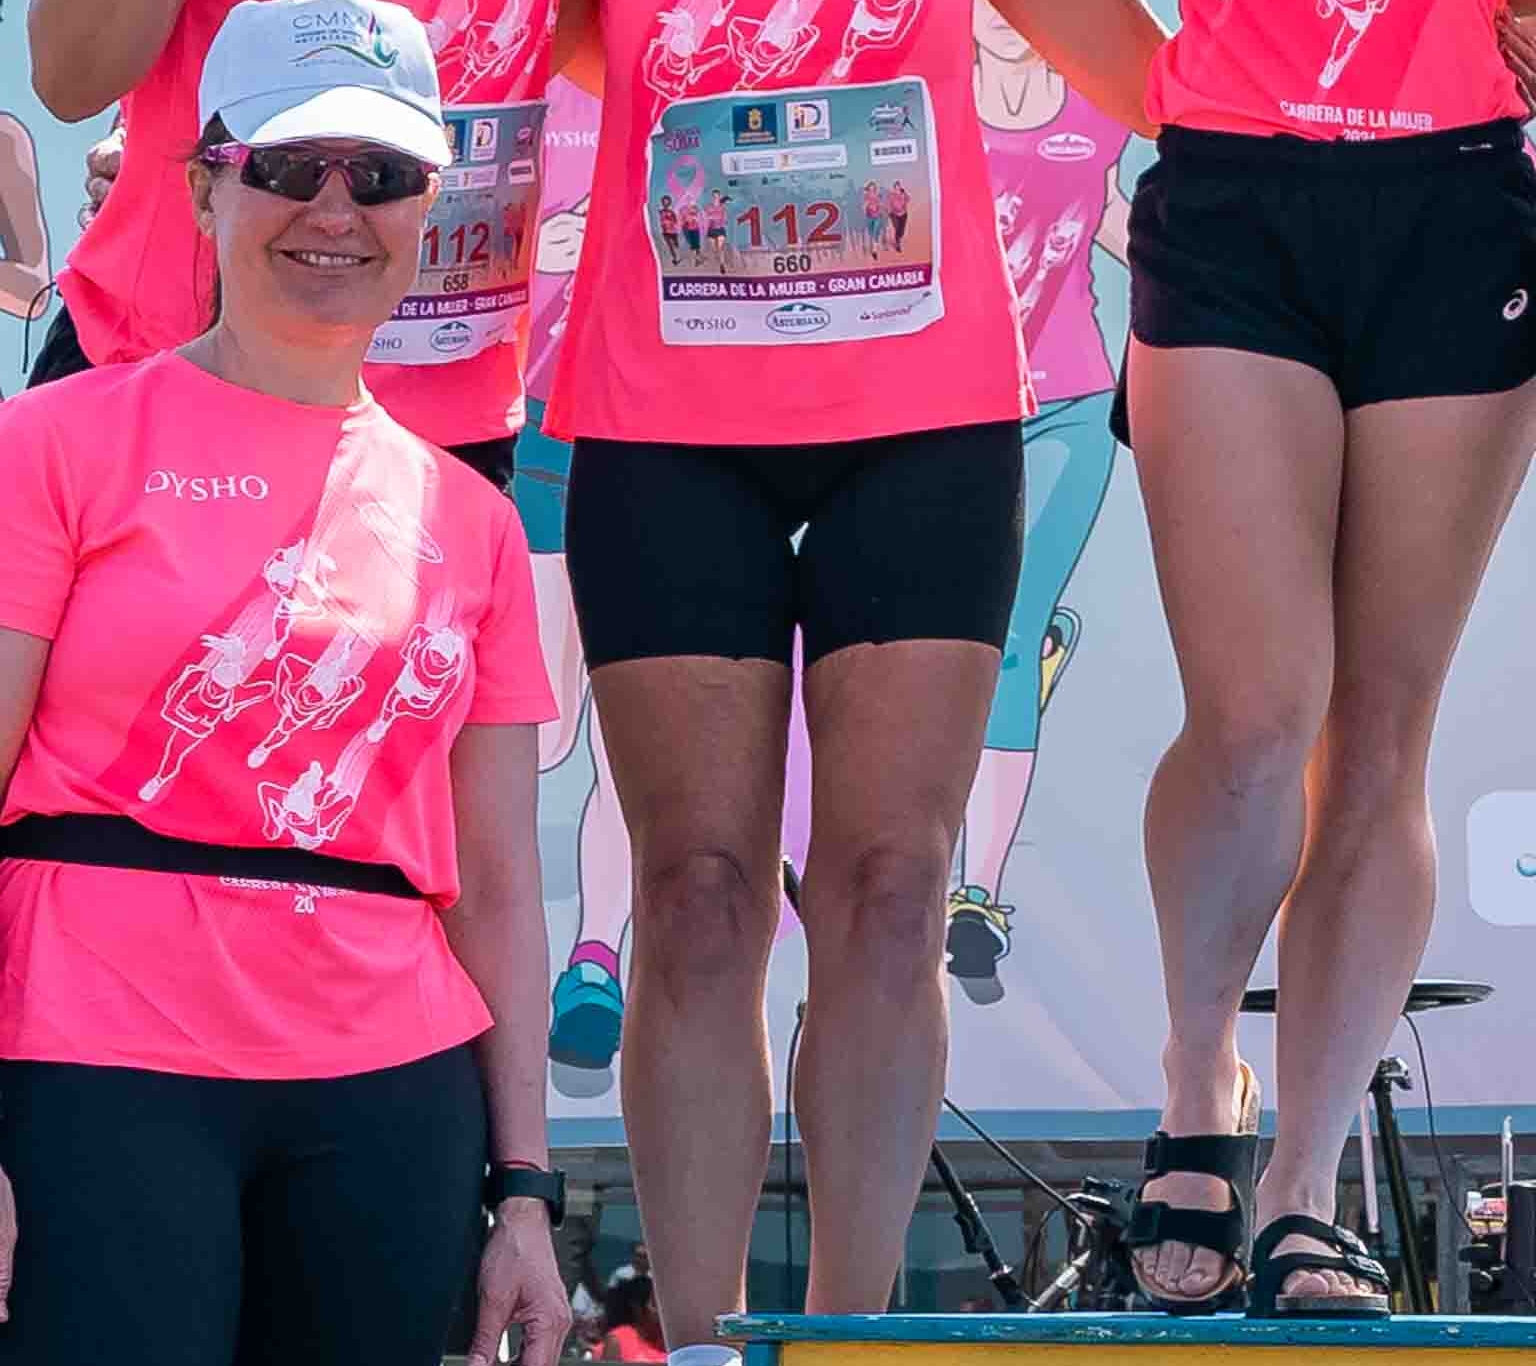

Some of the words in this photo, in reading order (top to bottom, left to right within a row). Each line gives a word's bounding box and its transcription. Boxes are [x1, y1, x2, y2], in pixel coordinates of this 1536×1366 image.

[1279, 100, 1343, 123] CARRERA
[1346, 108, 1365, 125] DE
[1368, 109, 1387, 128] LA
[1390, 109, 1433, 132] MUJER
[736, 202, 843, 248] 112
[422, 221, 490, 266] 112
[773, 254, 812, 274] 660
[669, 282, 728, 298] CARRERA
[730, 283, 750, 297] DE
[752, 283, 766, 297] LA
[768, 281, 817, 297] MUJER
[828, 276, 865, 293] GRAN
[868, 270, 925, 288] CANARIA
[401, 301, 418, 316] DE
[420, 300, 435, 315] LA
[373, 338, 402, 350] SHO
[144, 470, 270, 502] OYSHO
